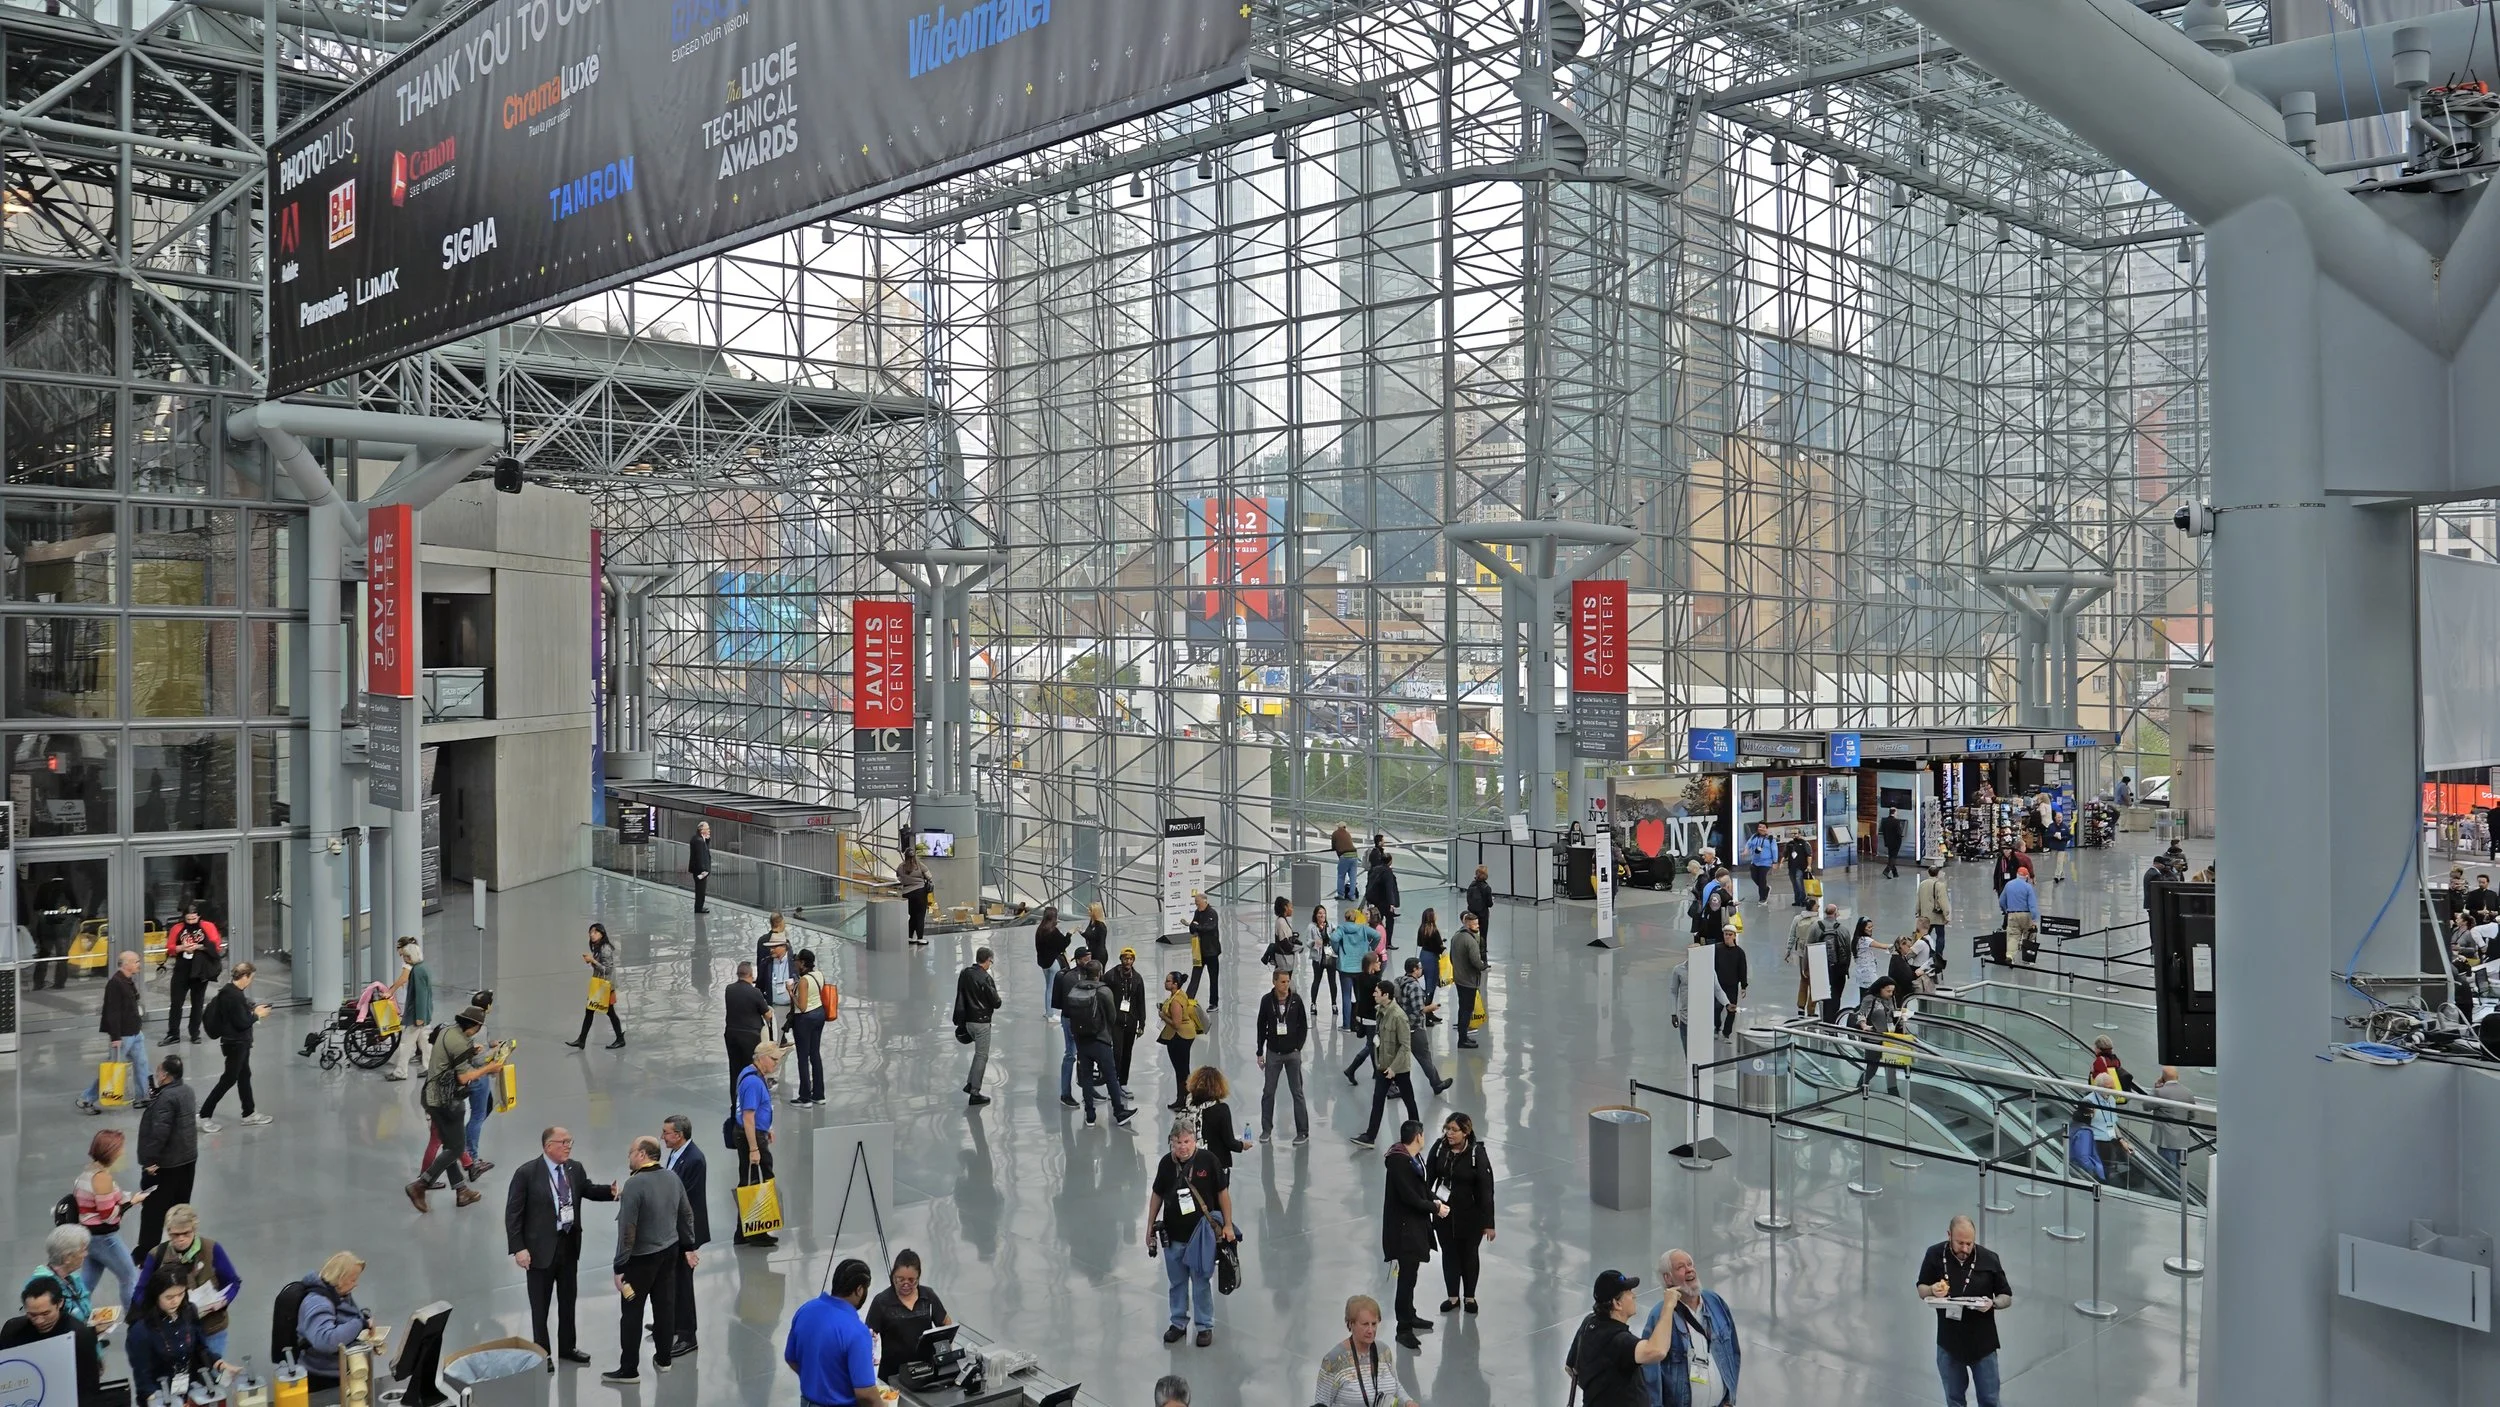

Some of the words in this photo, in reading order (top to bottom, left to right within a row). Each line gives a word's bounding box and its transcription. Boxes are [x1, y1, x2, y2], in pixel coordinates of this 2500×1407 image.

[396, 49, 461, 127] THANK
[465, 16, 510, 83] YOU
[517, 0, 549, 51] TO
[672, 38, 700, 62] EXCEED
[701, 27, 722, 47] YOUR
[724, 12, 749, 35] VISION
[503, 53, 600, 130] ChromaLuxe
[726, 80, 741, 104] The
[741, 42, 797, 99] LUCIE
[702, 84, 798, 149] TECHNICAL
[280, 117, 354, 195] PHOTOPLUS
[410, 135, 456, 181] Canon
[718, 118, 799, 180] AWARDS
[550, 156, 635, 222] TAMRON
[442, 216, 498, 271] SIGMA
[300, 286, 348, 328] Panasonic
[356, 267, 400, 306] LUMIX
[374, 535, 384, 666] JAVITS
[385, 533, 394, 667] CENTER
[866, 617, 883, 710] JAVITS
[890, 618, 904, 711] CENTER
[1583, 596, 1597, 675] JAVITS
[1602, 596, 1614, 676] CENTER
[870, 727, 900, 751] 1C
[1588, 798, 1594, 808] I
[1588, 811, 1608, 822] NY
[1665, 815, 1718, 857] NY
[745, 1219, 780, 1232] Nikon
